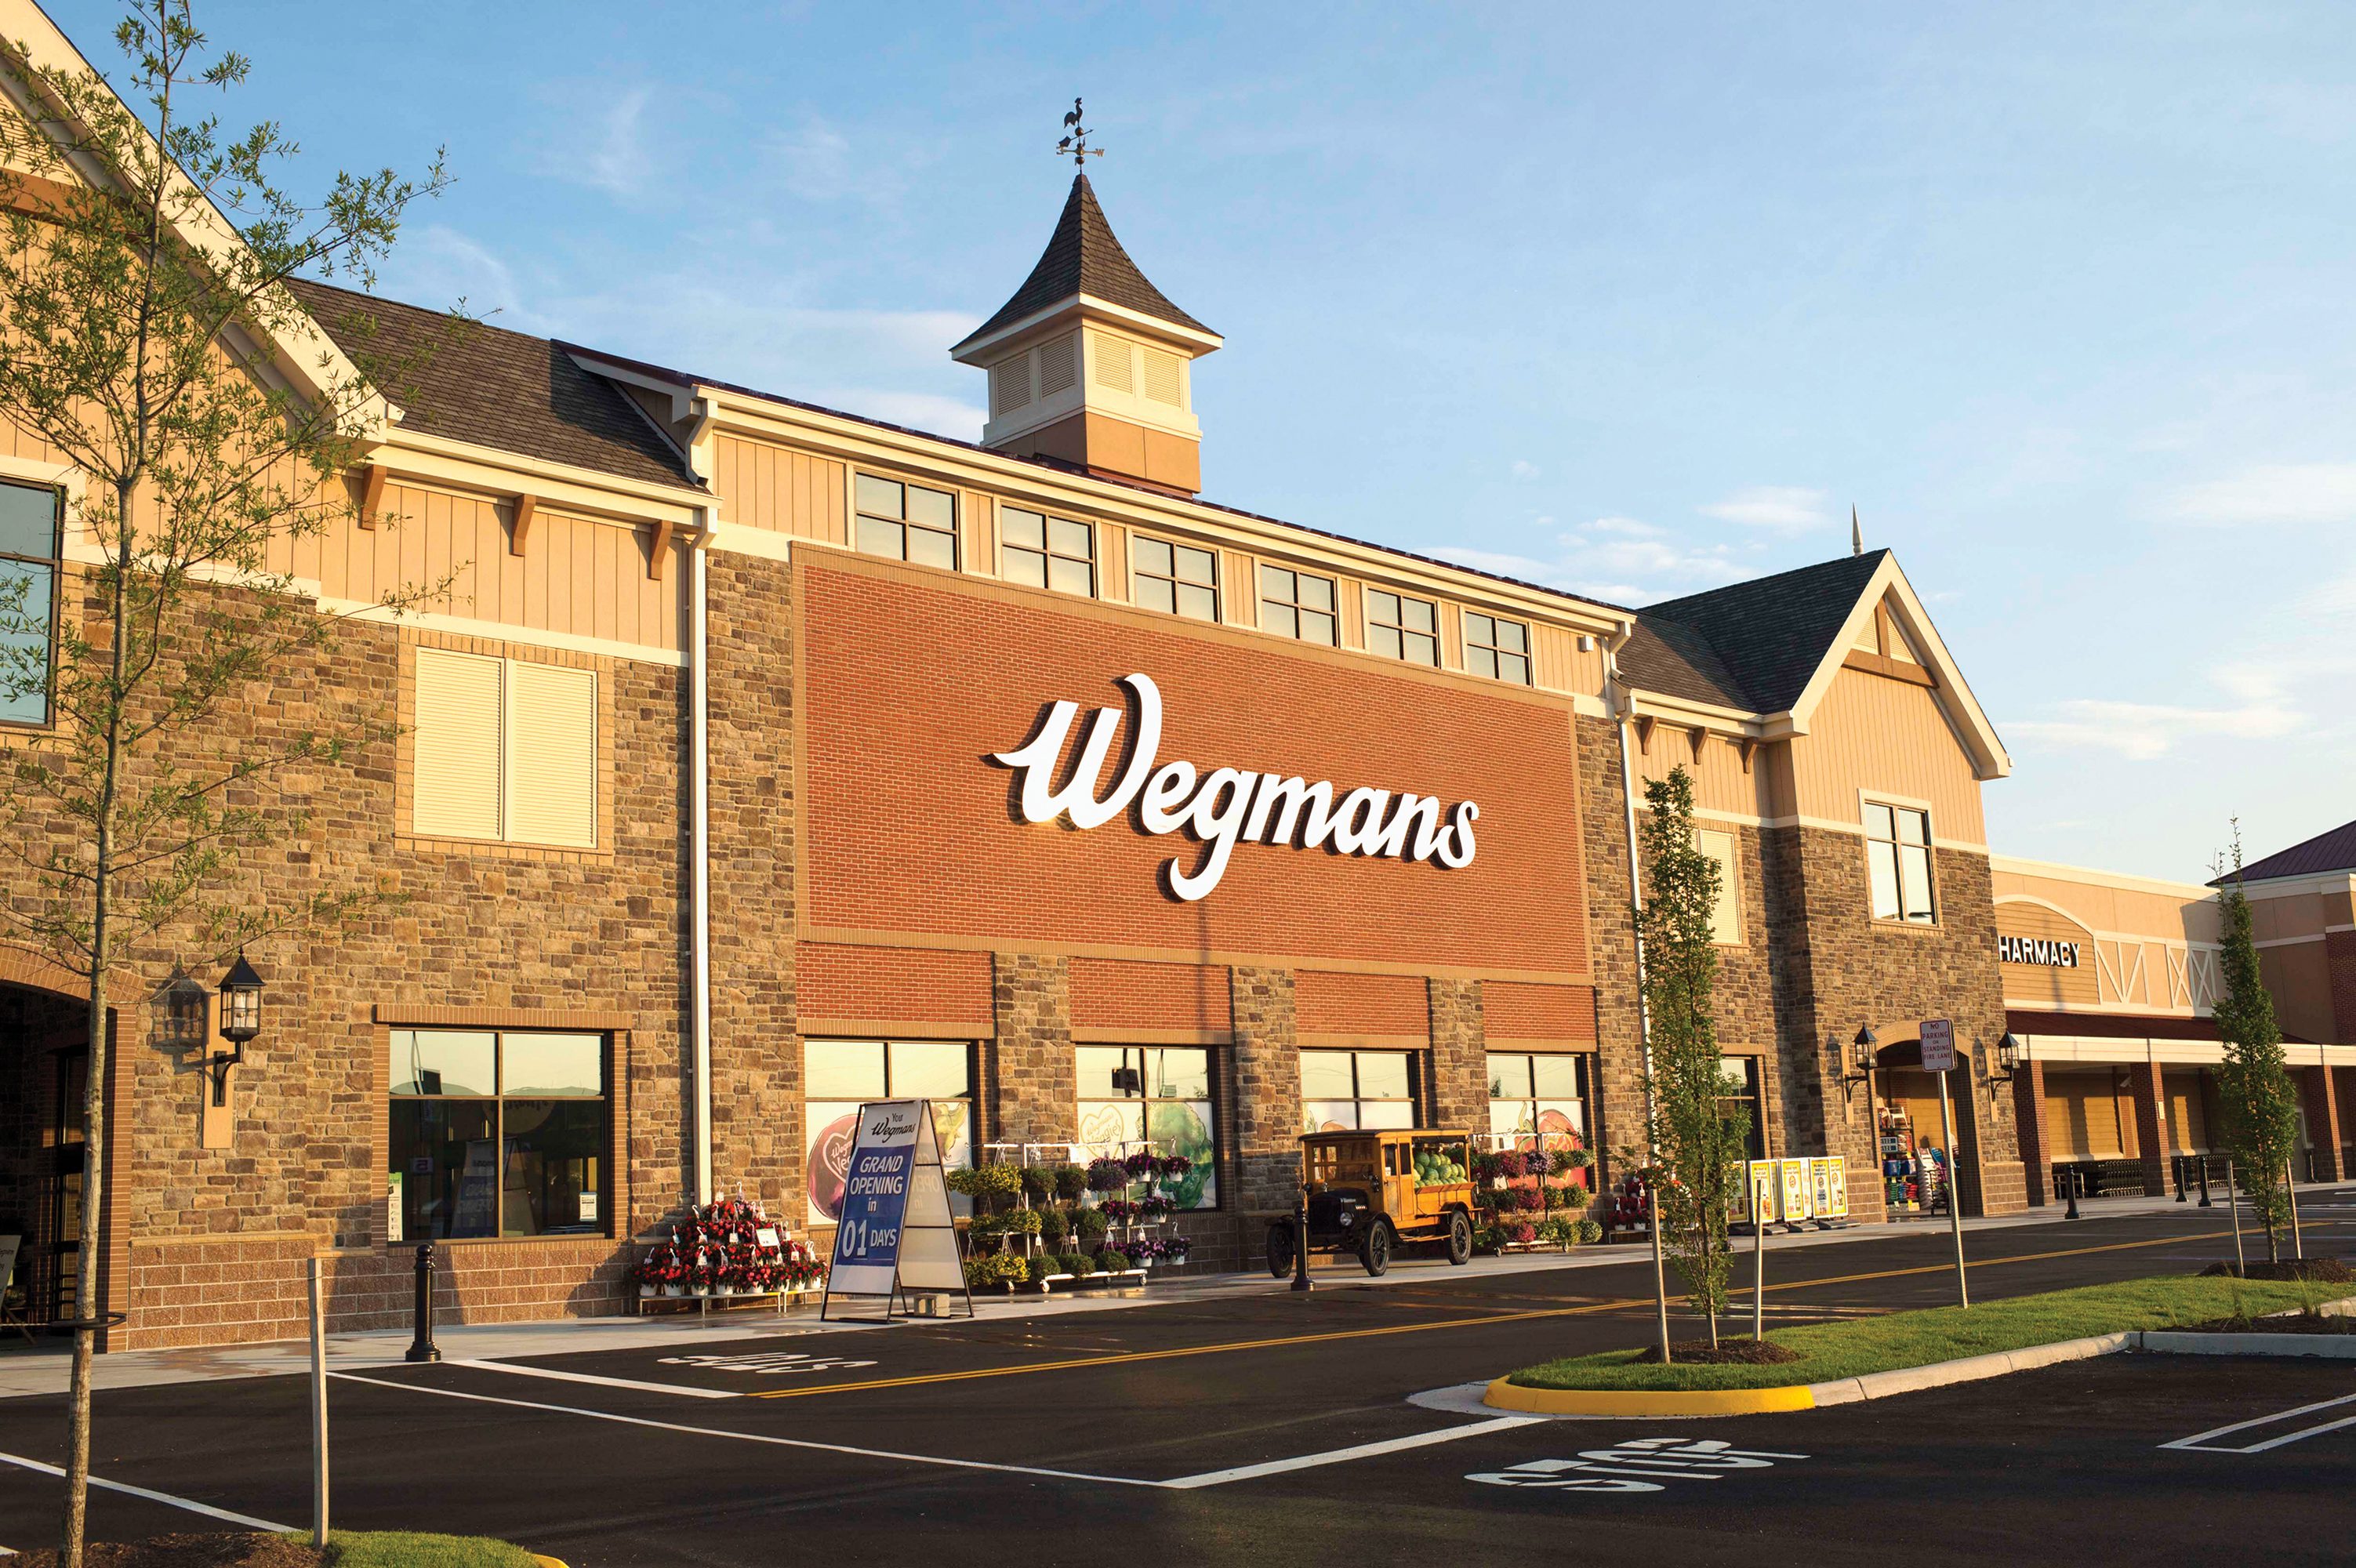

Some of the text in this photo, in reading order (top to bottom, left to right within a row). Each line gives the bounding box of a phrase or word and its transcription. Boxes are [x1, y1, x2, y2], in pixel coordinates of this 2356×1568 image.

[993, 673, 1479, 902] Wegmans
[1998, 935, 2080, 967] HARMACY
[1922, 1031, 1948, 1040] PARKING
[1923, 1044, 1950, 1053] STANDING
[892, 1113, 903, 1122] Your
[871, 1117, 916, 1143] Wegmans
[859, 1156, 904, 1174] GRAND
[850, 1176, 903, 1195] OPENING
[867, 1197, 877, 1211] in
[842, 1219, 898, 1258] 01 DAYS
[657, 1352, 879, 1374] STOP
[1464, 1438, 1811, 1492] STOP
